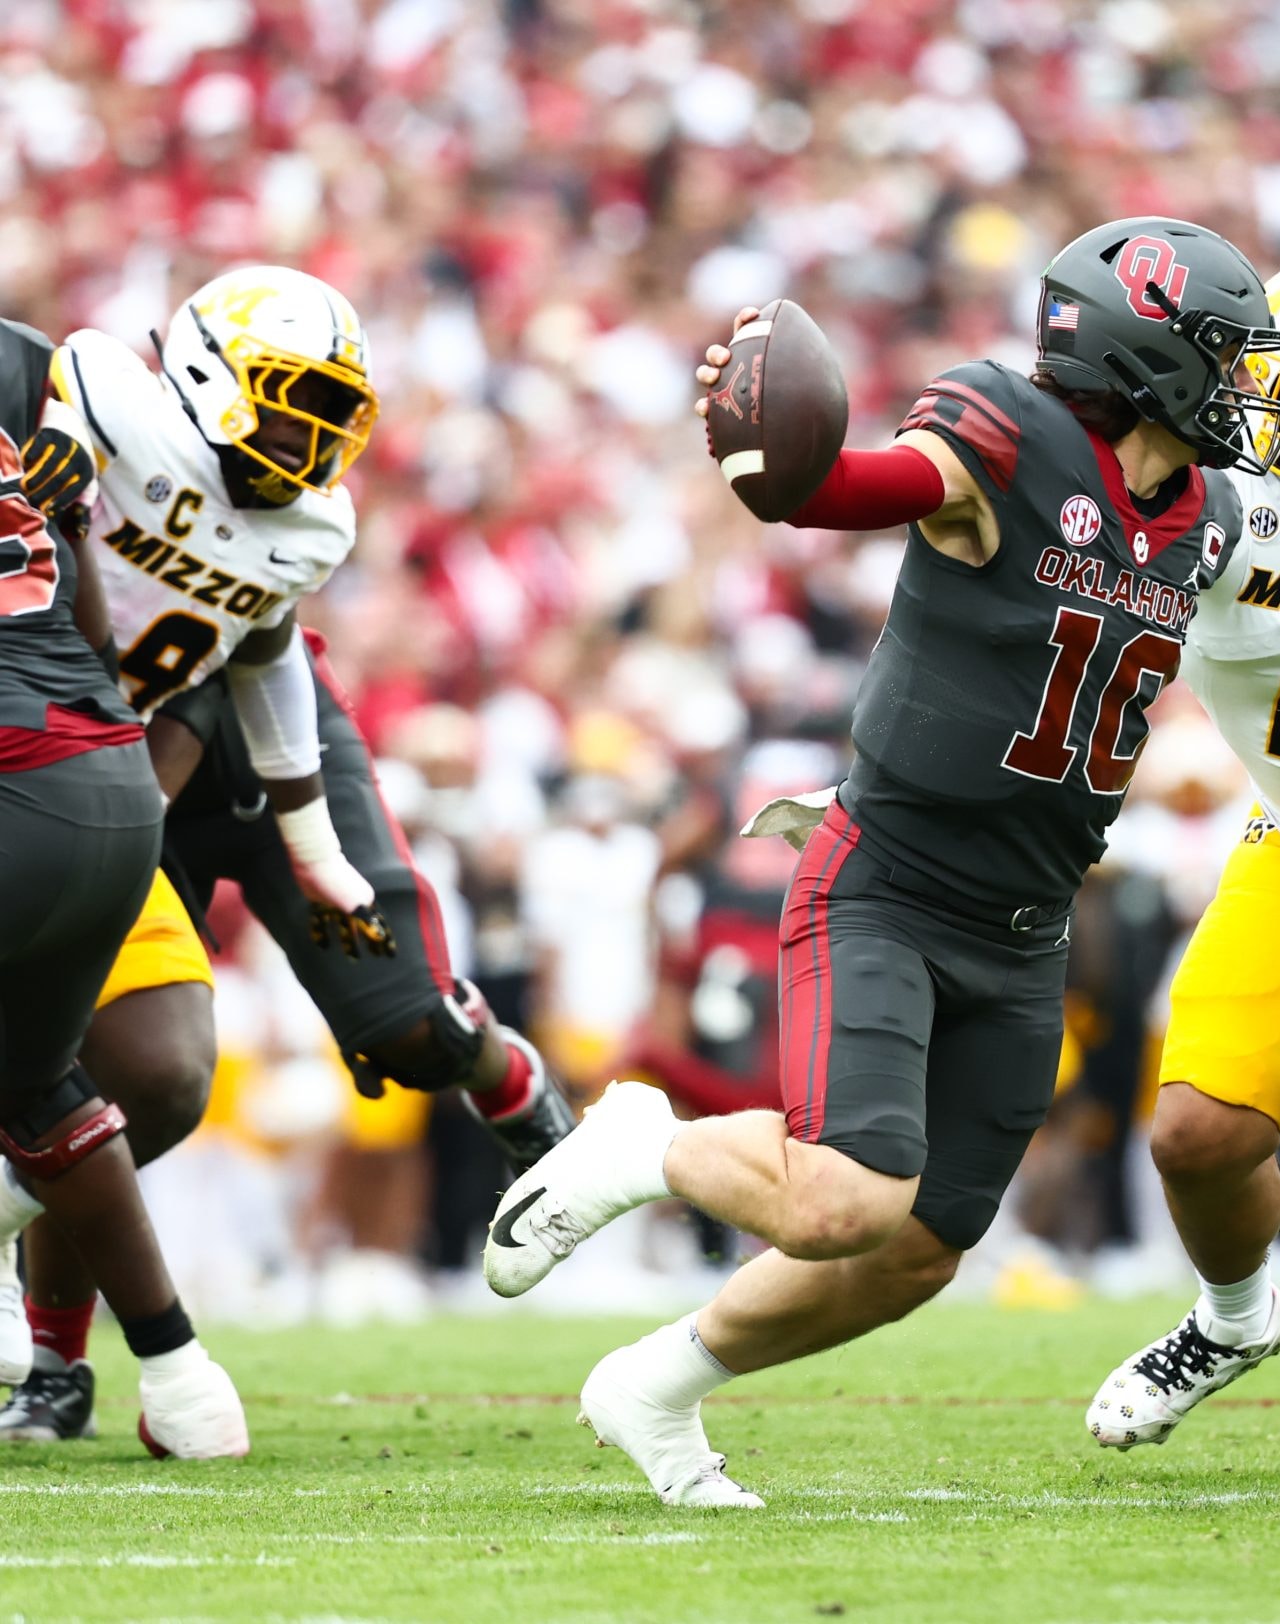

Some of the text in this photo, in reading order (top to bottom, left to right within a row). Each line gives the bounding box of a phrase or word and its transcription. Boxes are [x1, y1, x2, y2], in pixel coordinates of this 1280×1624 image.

[1115, 235, 1189, 322] OU
[164, 487, 205, 541] C
[1062, 498, 1099, 543] SEC
[1250, 507, 1278, 537] SEC
[1133, 531, 1149, 563] OU
[1034, 546, 1198, 633] OKLAHOM
[1000, 606, 1183, 795] 10
